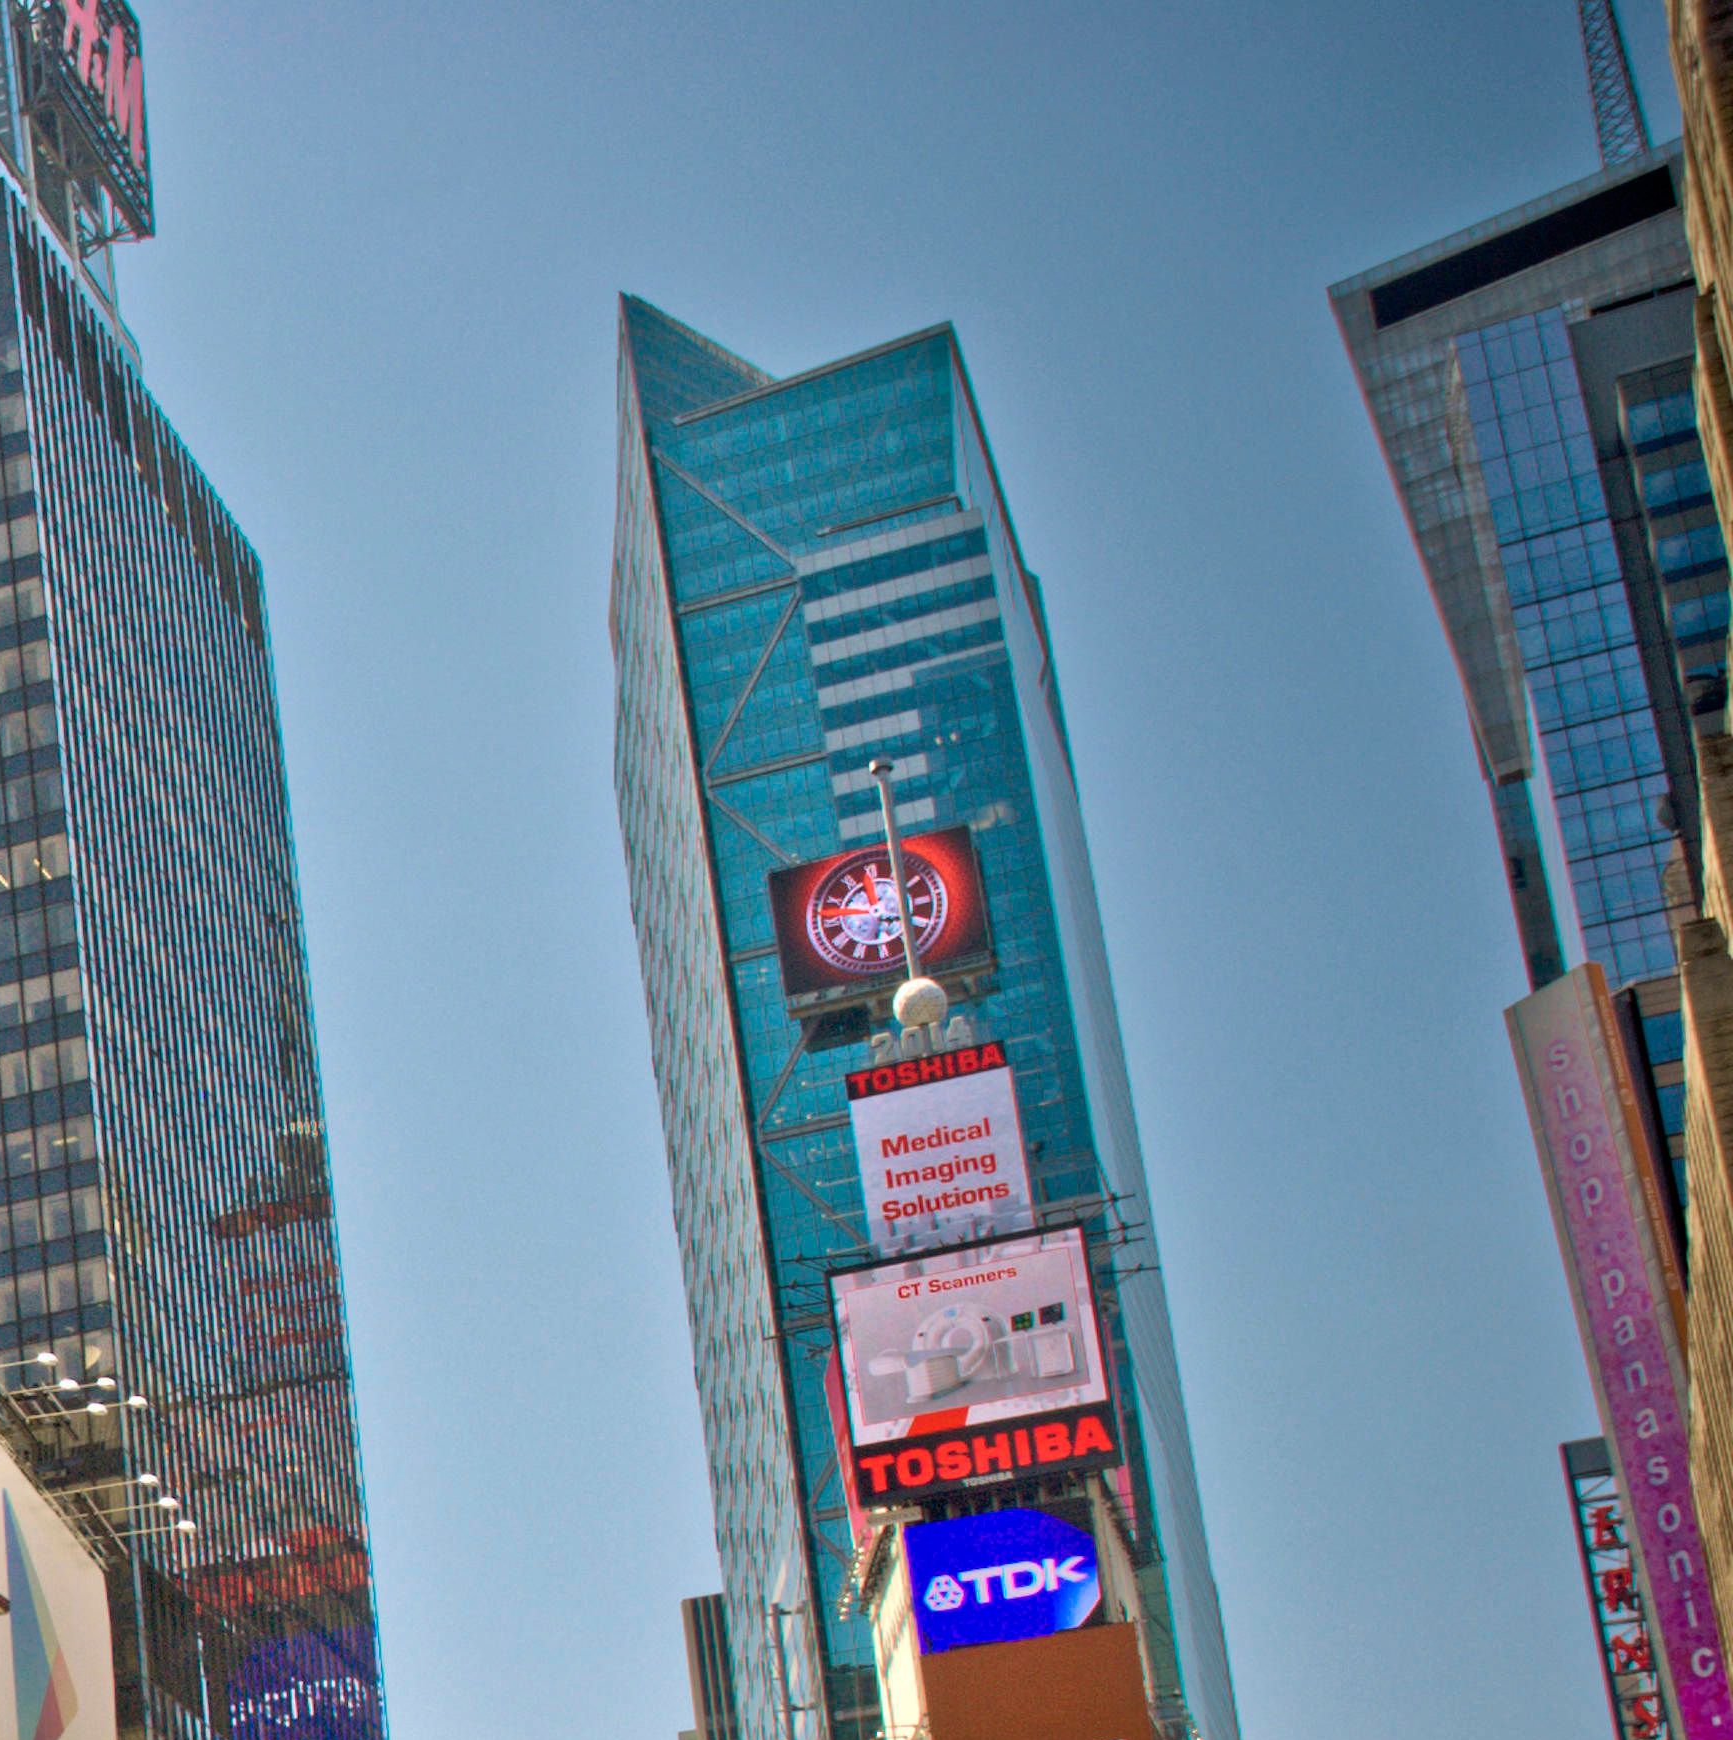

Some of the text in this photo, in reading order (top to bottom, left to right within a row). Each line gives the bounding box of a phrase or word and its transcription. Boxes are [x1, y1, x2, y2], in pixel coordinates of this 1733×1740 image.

[850, 1042, 1006, 1098] TOSHIBA
[881, 1117, 992, 1158] Medical
[885, 1150, 997, 1189] Imaging
[882, 1179, 1011, 1222] Solutions
[897, 1265, 1018, 1300] CT Scanners
[860, 1415, 1114, 1493] TOSHIBA
[957, 1553, 1090, 1604] TDK
